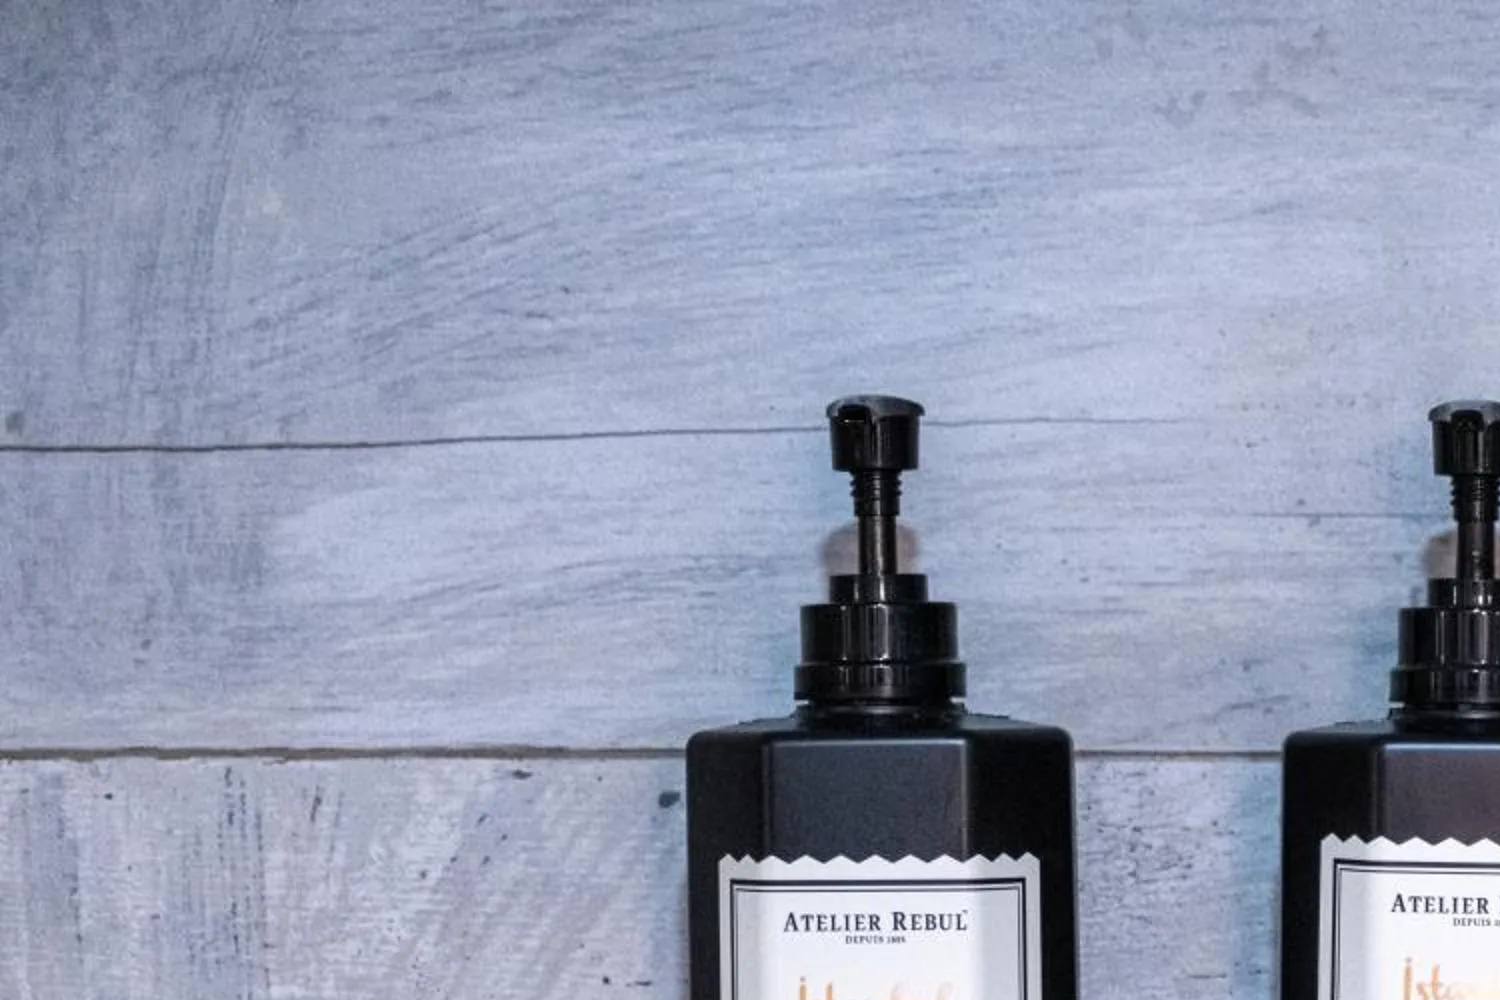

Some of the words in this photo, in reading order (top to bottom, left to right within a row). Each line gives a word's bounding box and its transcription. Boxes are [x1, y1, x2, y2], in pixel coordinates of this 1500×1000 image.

[1391, 893, 1490, 915] ATELIER
[784, 911, 881, 932] ATELIER
[1453, 917, 1491, 927] DEPUIS
[845, 935, 884, 945] DEPUIS
